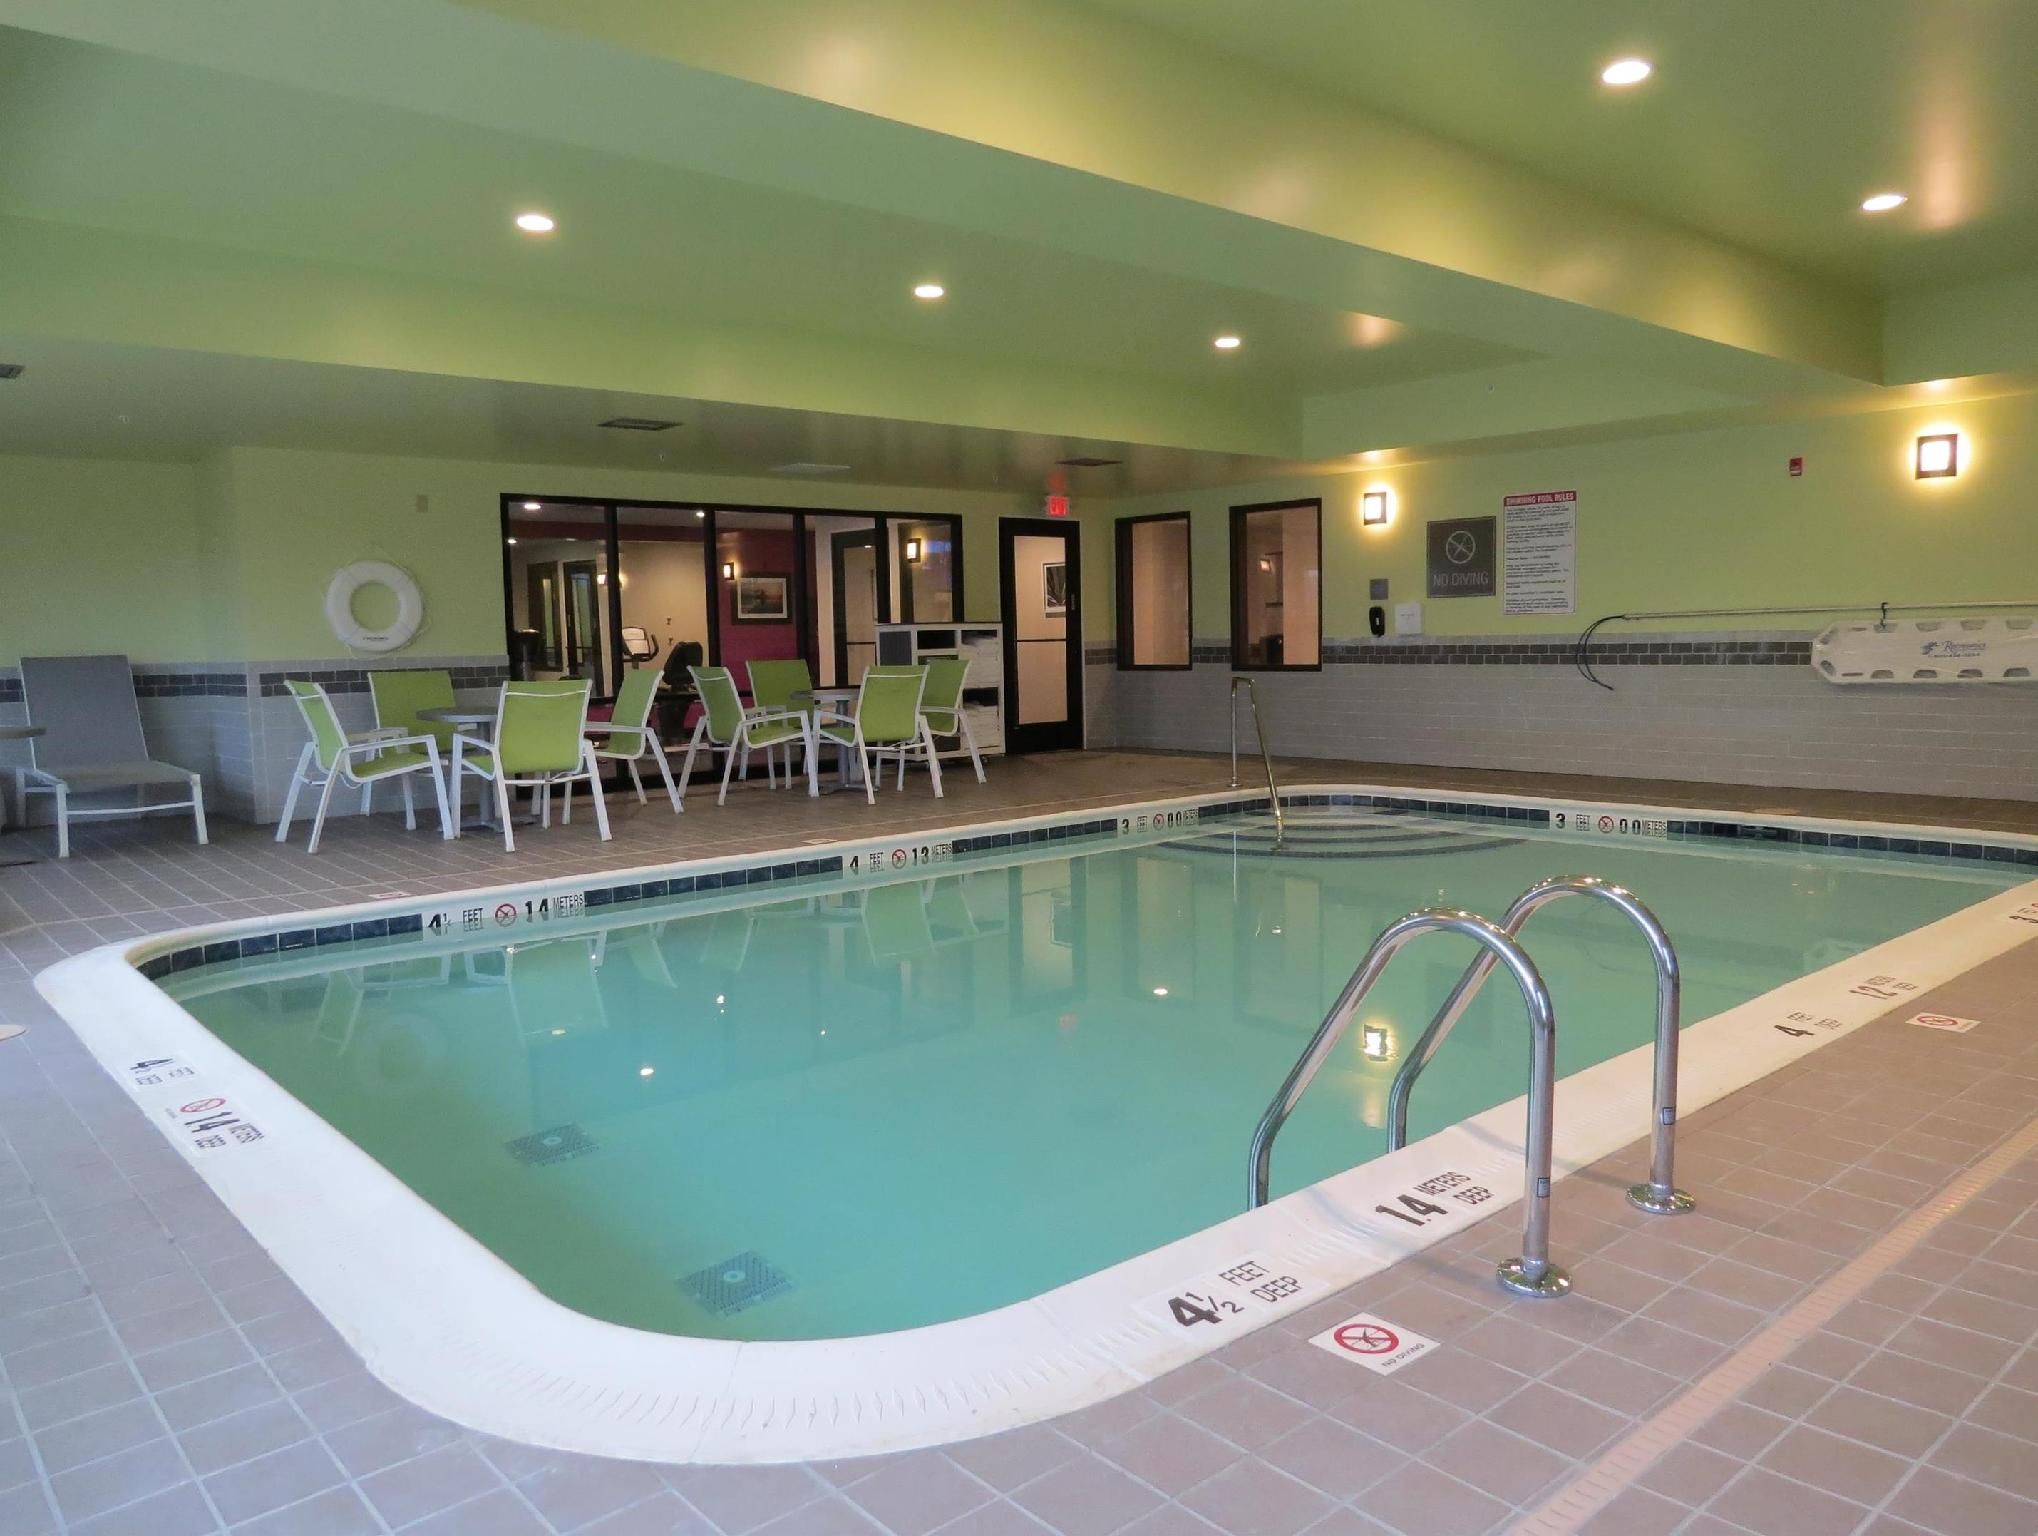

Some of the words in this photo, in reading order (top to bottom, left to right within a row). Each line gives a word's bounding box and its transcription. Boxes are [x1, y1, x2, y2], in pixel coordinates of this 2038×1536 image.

[1555, 492, 1574, 502] RULES
[1433, 573, 1448, 586] NO
[1451, 571, 1489, 586] DIVING
[463, 907, 484, 923] FEET
[552, 894, 585, 911] METERS
[1375, 1193, 1449, 1227] 1.4
[1412, 1171, 1472, 1196] METERS
[1453, 1186, 1495, 1205] DEEP
[1218, 1260, 1271, 1286] FEET
[1250, 1275, 1306, 1303] DEEP
[1381, 1357, 1398, 1368] NO
[1397, 1342, 1426, 1360] DIVING
